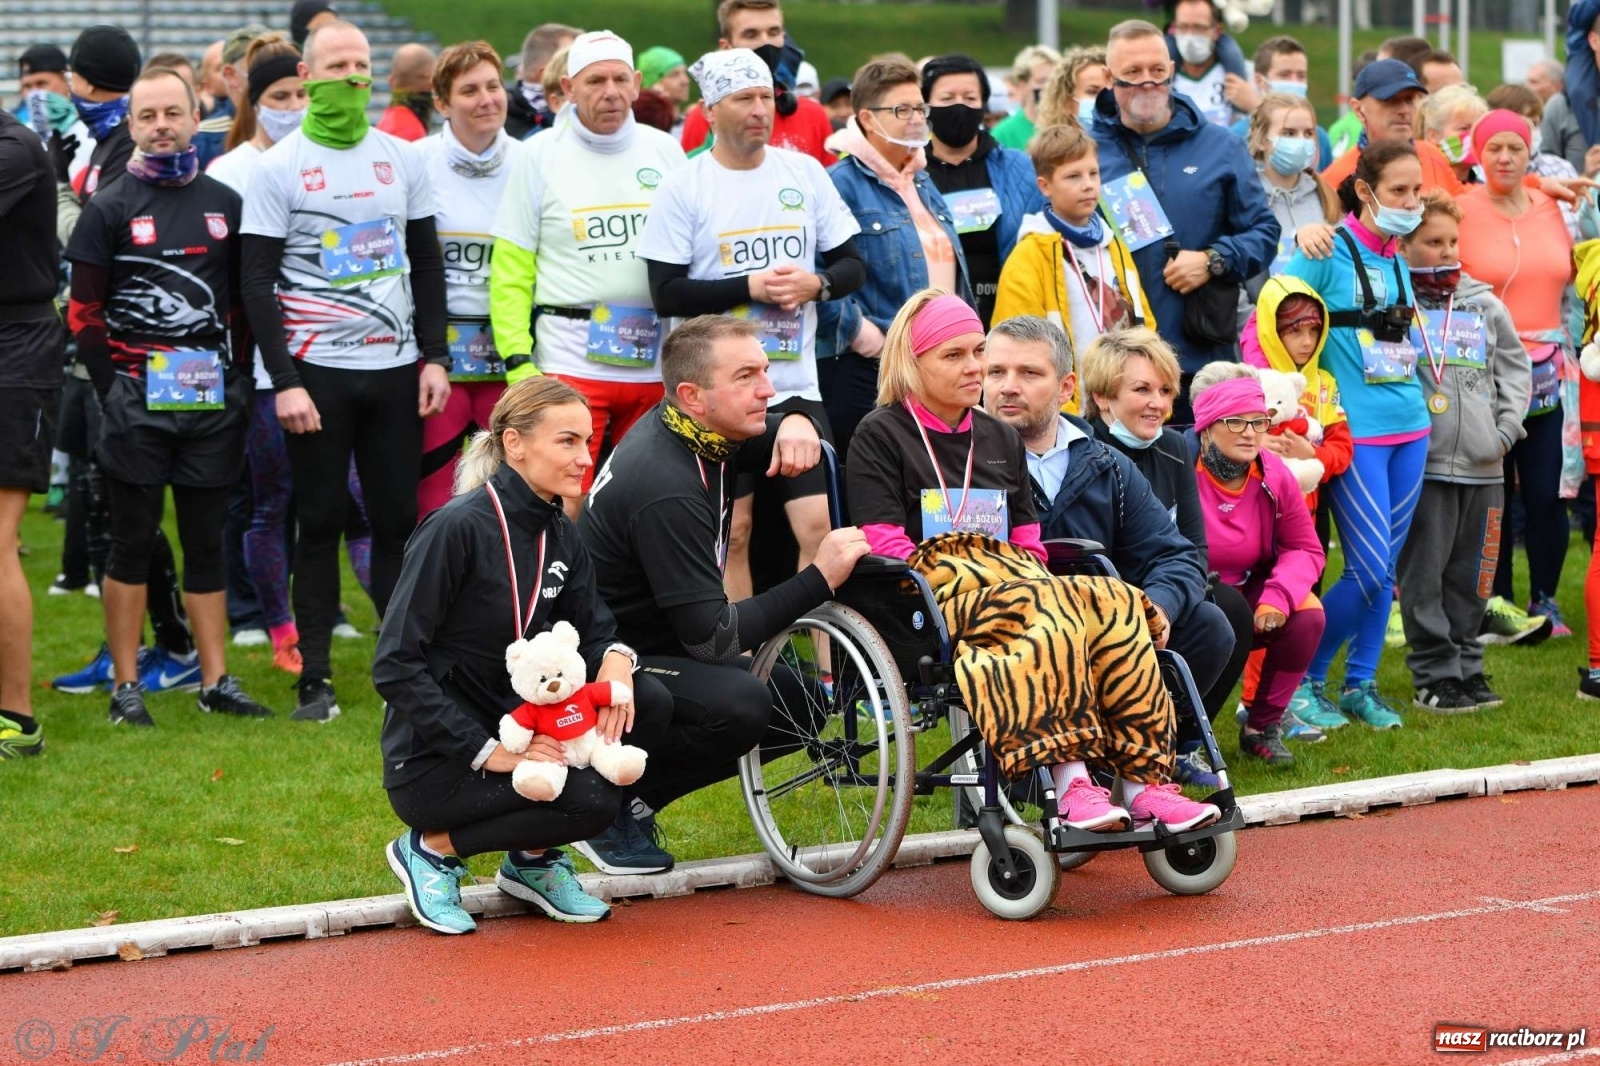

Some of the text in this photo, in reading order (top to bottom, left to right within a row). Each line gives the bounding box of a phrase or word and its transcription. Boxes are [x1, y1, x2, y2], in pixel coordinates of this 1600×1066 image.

[579, 213, 648, 251] agr
[724, 226, 807, 276] agrol
[631, 347, 653, 359] 255
[196, 390, 218, 404] 218
[558, 714, 582, 726] ORLEN
